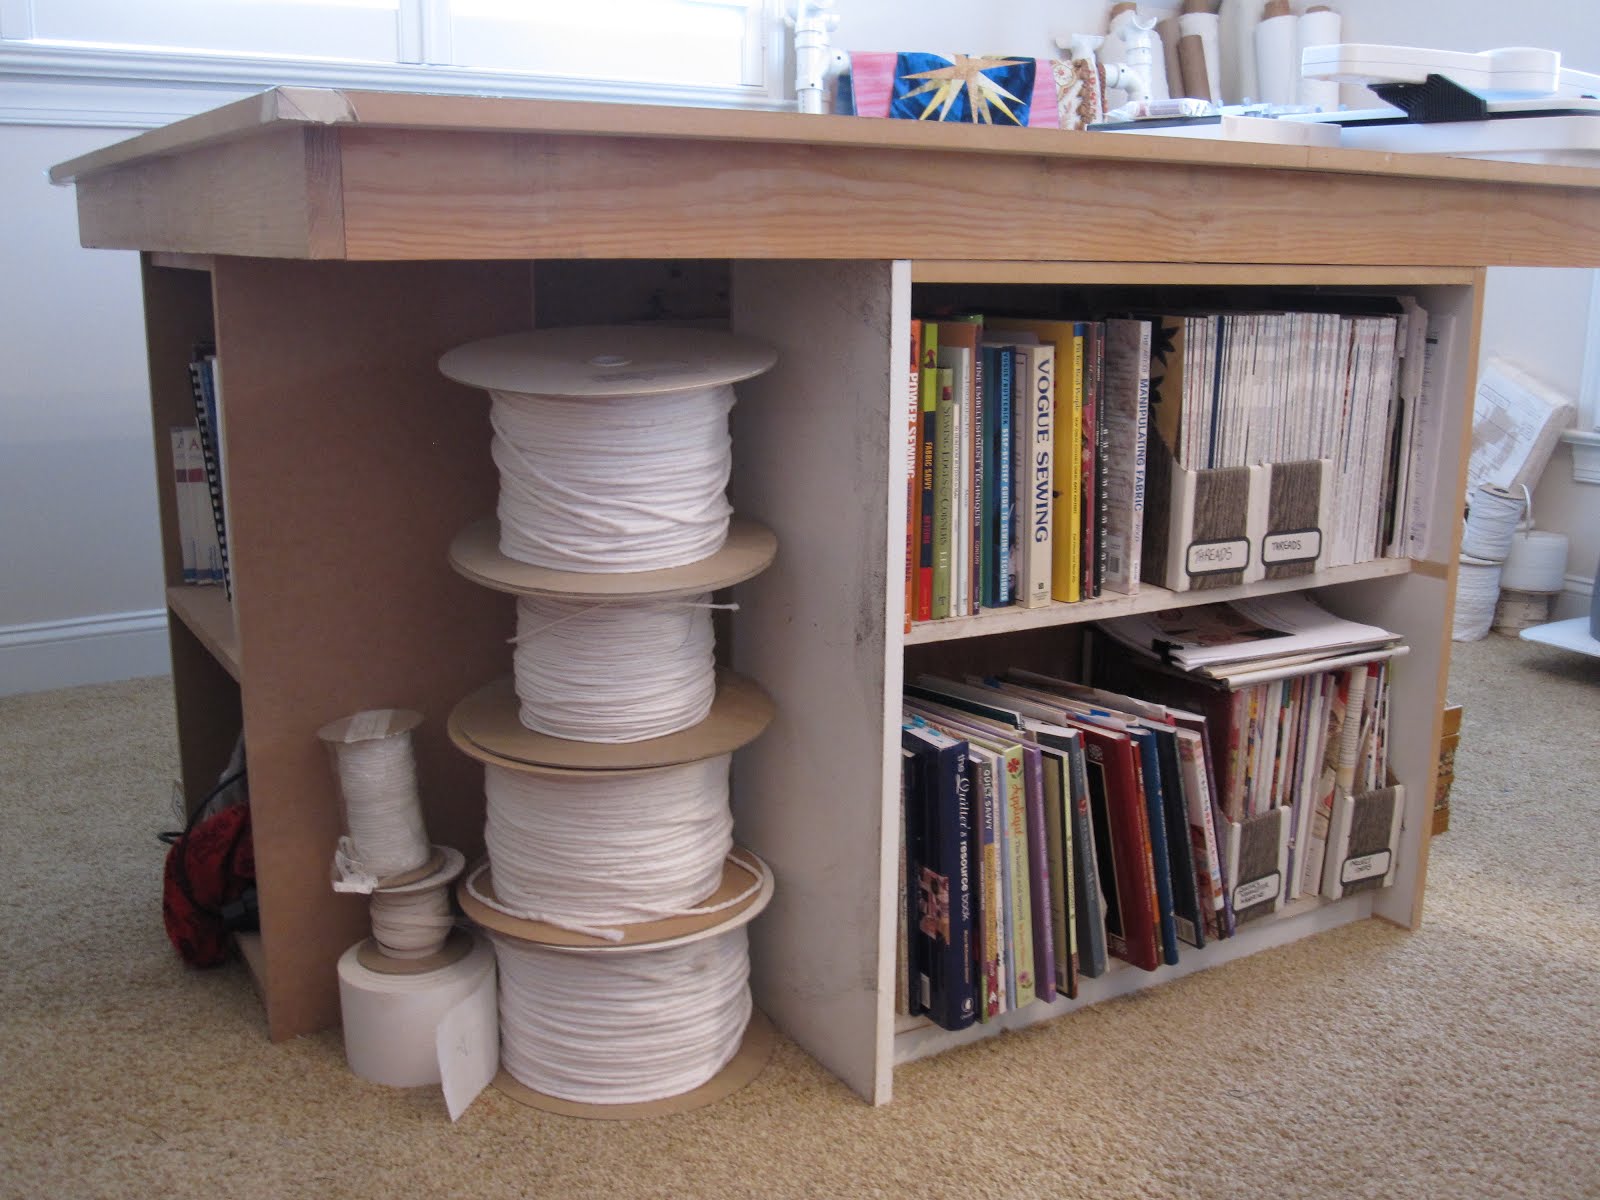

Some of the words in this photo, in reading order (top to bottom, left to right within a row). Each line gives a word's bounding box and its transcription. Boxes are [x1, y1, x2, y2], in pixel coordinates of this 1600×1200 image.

[908, 372, 918, 422] POWER
[1037, 359, 1050, 444] VOGUE
[1136, 379, 1148, 466] MANIPULATING
[906, 426, 917, 479] SEWING
[924, 442, 933, 467] FABRIC
[924, 468, 932, 490] SAVVY
[1134, 470, 1144, 511] FABRIC
[1036, 452, 1050, 543] SEWING
[1001, 512, 1008, 520] TO
[1194, 546, 1233, 563] THREADS
[1271, 540, 1302, 551] THREADS
[958, 754, 966, 772] the
[983, 769, 992, 798] QUILT
[984, 800, 993, 831] SAVVY
[960, 840, 969, 891] resource
[962, 893, 970, 921] book
